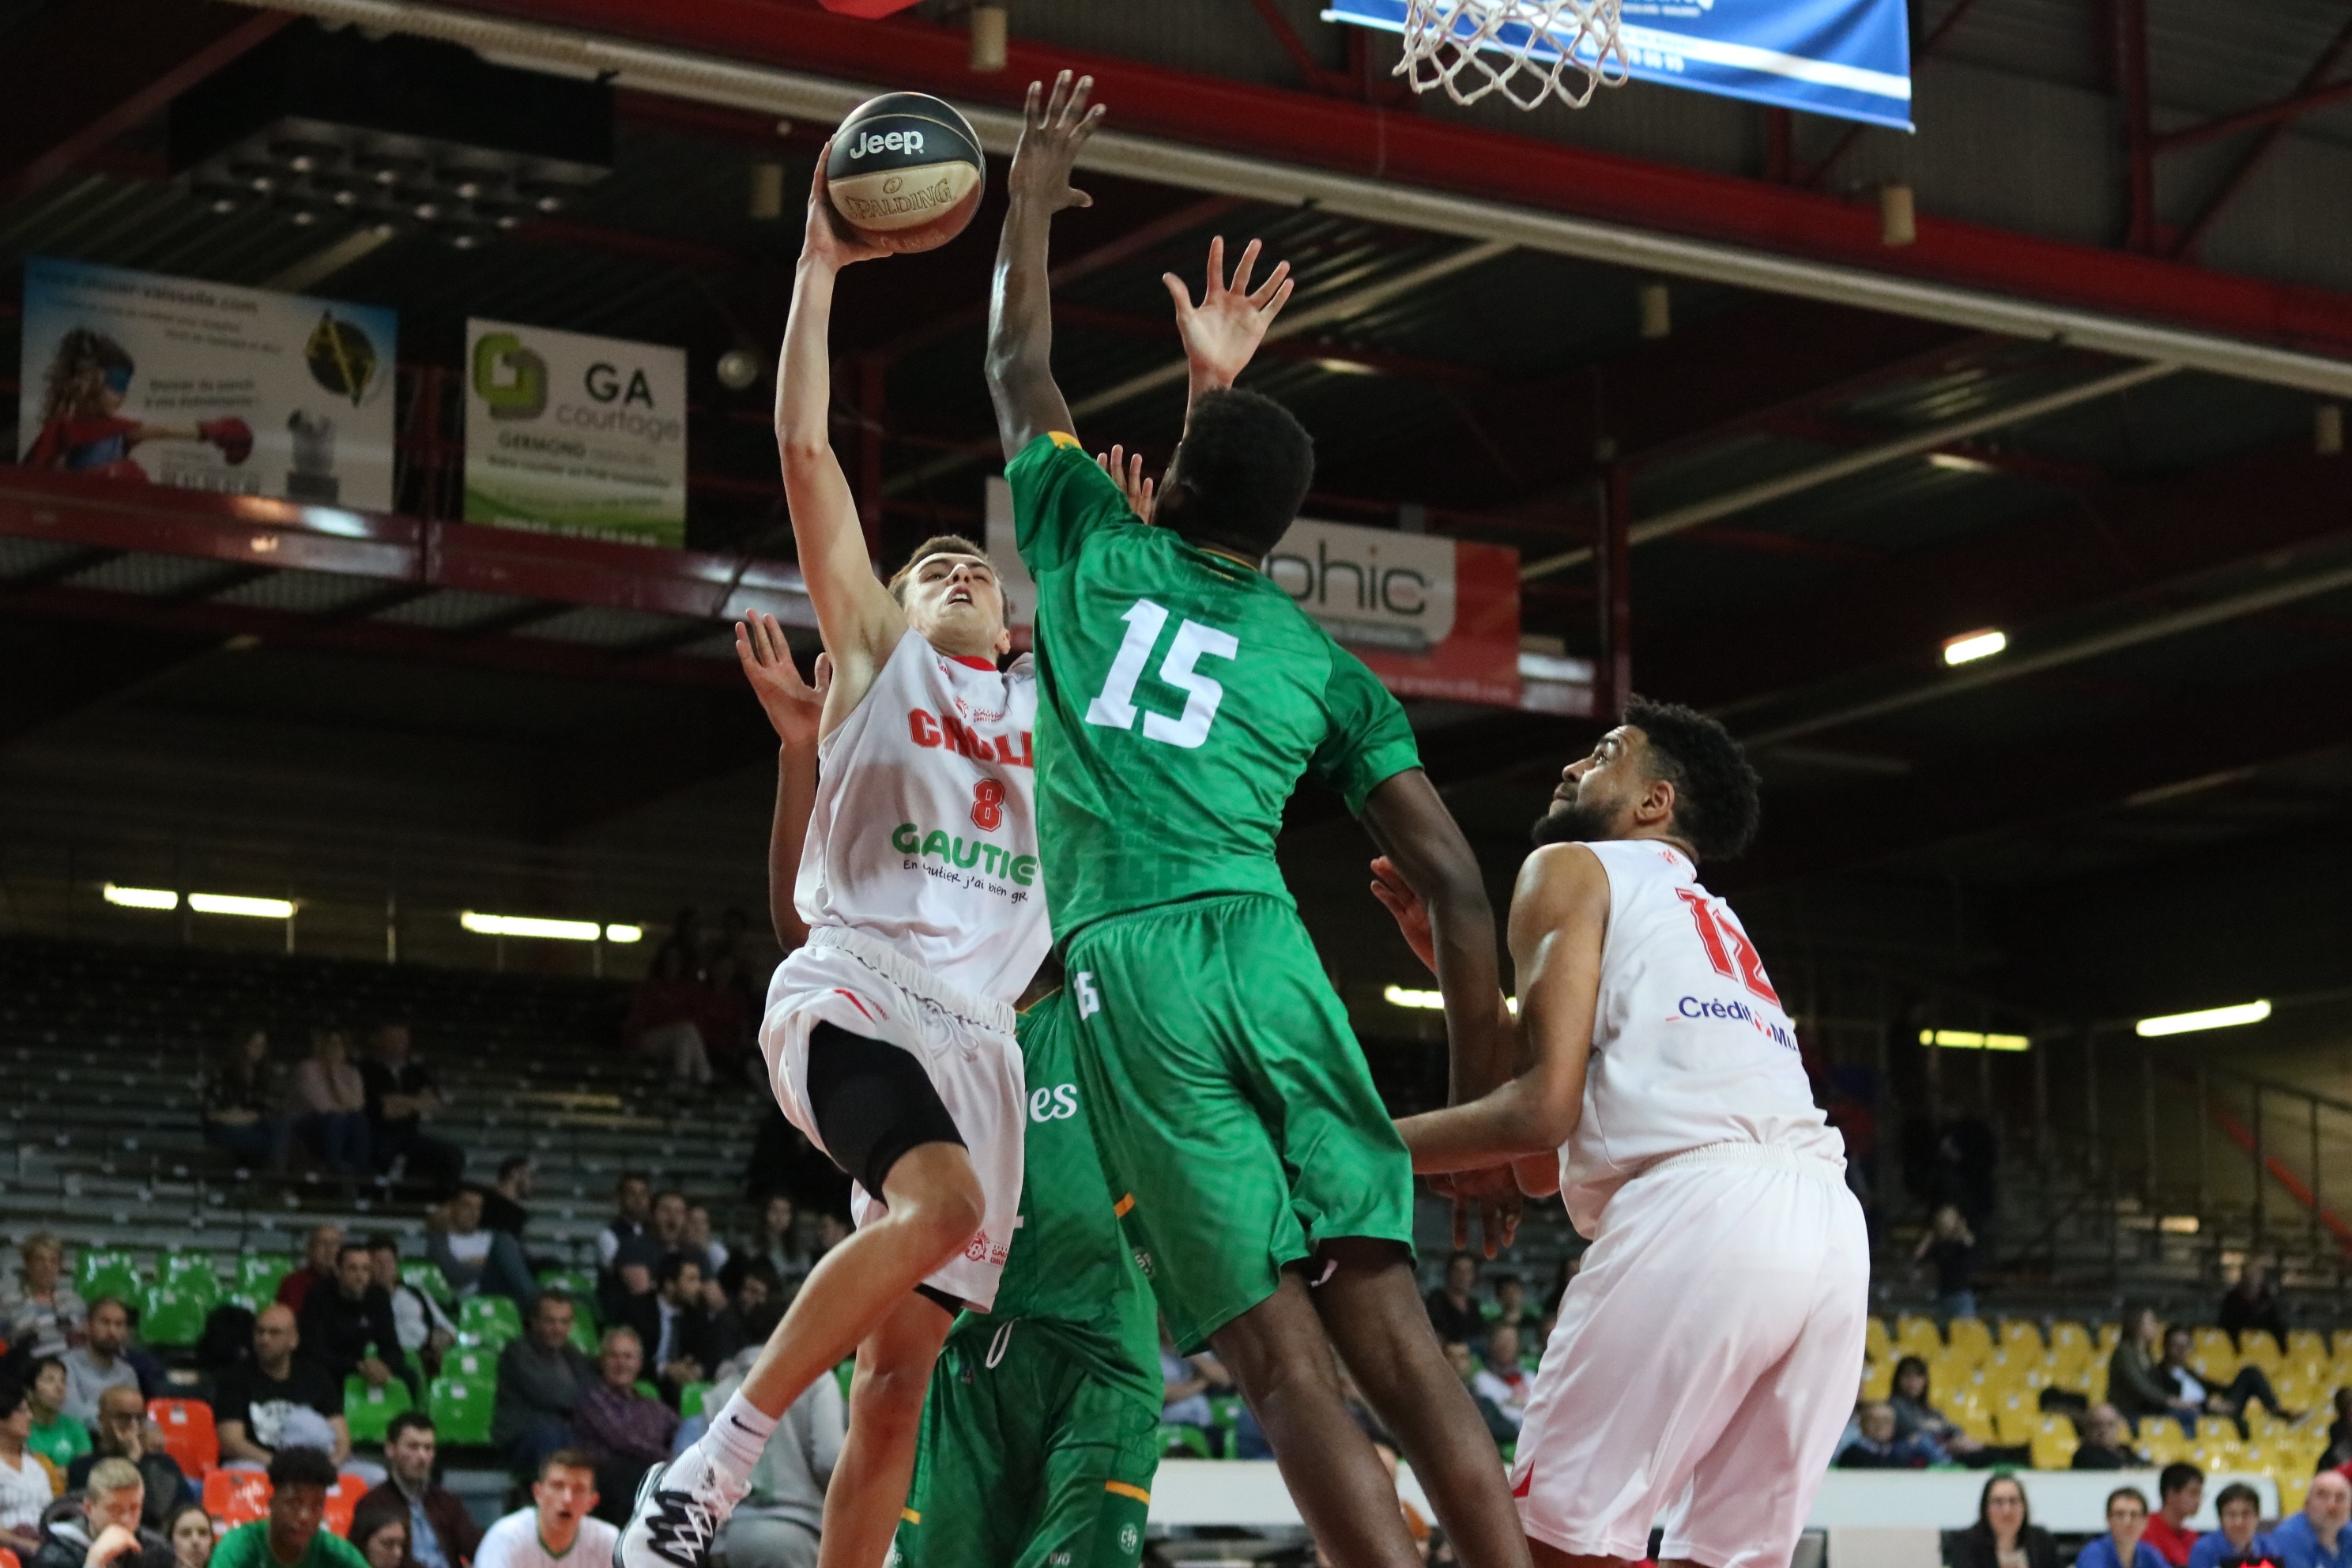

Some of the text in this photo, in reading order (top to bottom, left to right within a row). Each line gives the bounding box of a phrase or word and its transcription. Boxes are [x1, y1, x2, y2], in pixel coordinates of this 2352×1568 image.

[850, 131, 924, 159] Jeep
[846, 179, 952, 220] SPALDING
[584, 362, 654, 409] GA
[556, 403, 680, 444] courtage
[1084, 598, 1239, 749] 15
[970, 778, 1005, 833] 8
[903, 859, 918, 870] En
[989, 882, 1007, 897] bien
[1675, 888, 1782, 1008] 12
[1679, 996, 1755, 1027] Crédit
[1027, 1084, 1078, 1124] es
